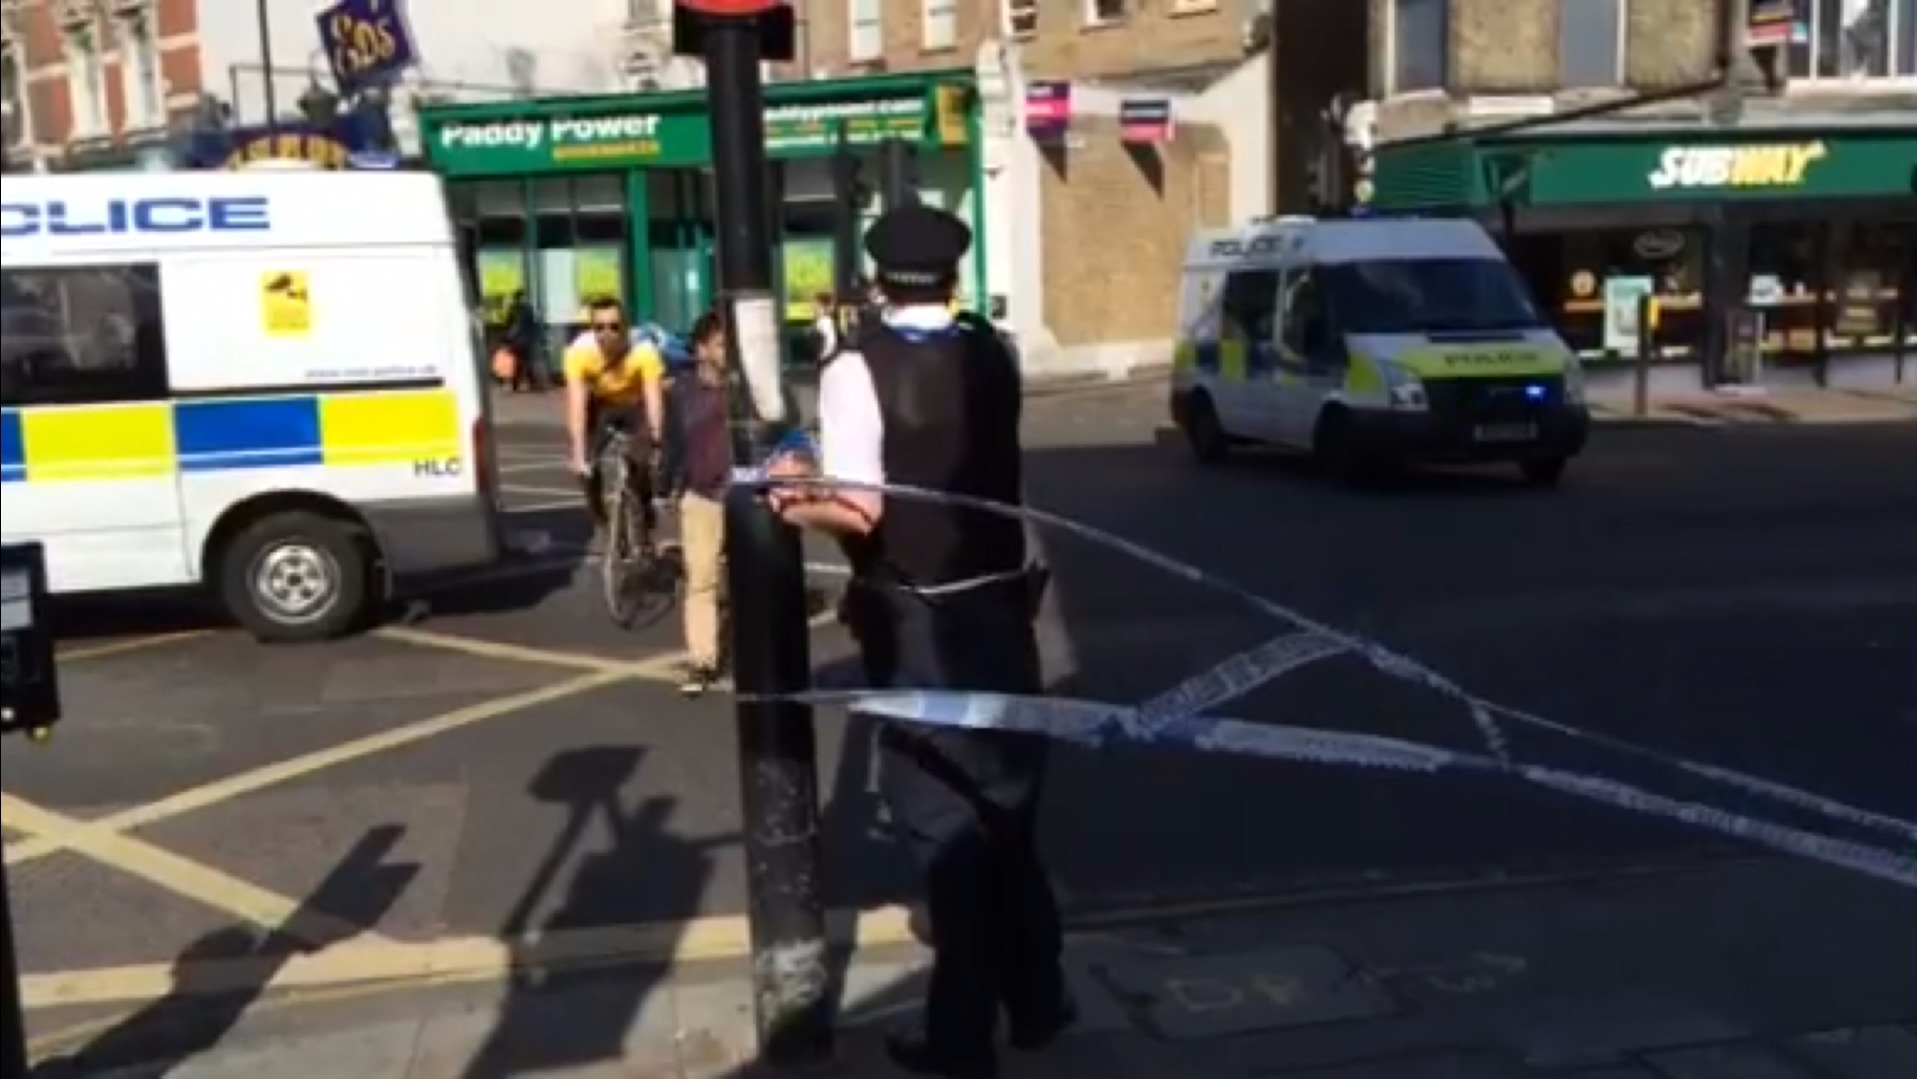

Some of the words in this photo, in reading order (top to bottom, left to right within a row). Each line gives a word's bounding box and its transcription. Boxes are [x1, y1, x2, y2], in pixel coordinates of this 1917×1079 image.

[441, 121, 544, 150] Paddy
[552, 113, 660, 141] Power
[1648, 138, 1827, 189] SUBWAY
